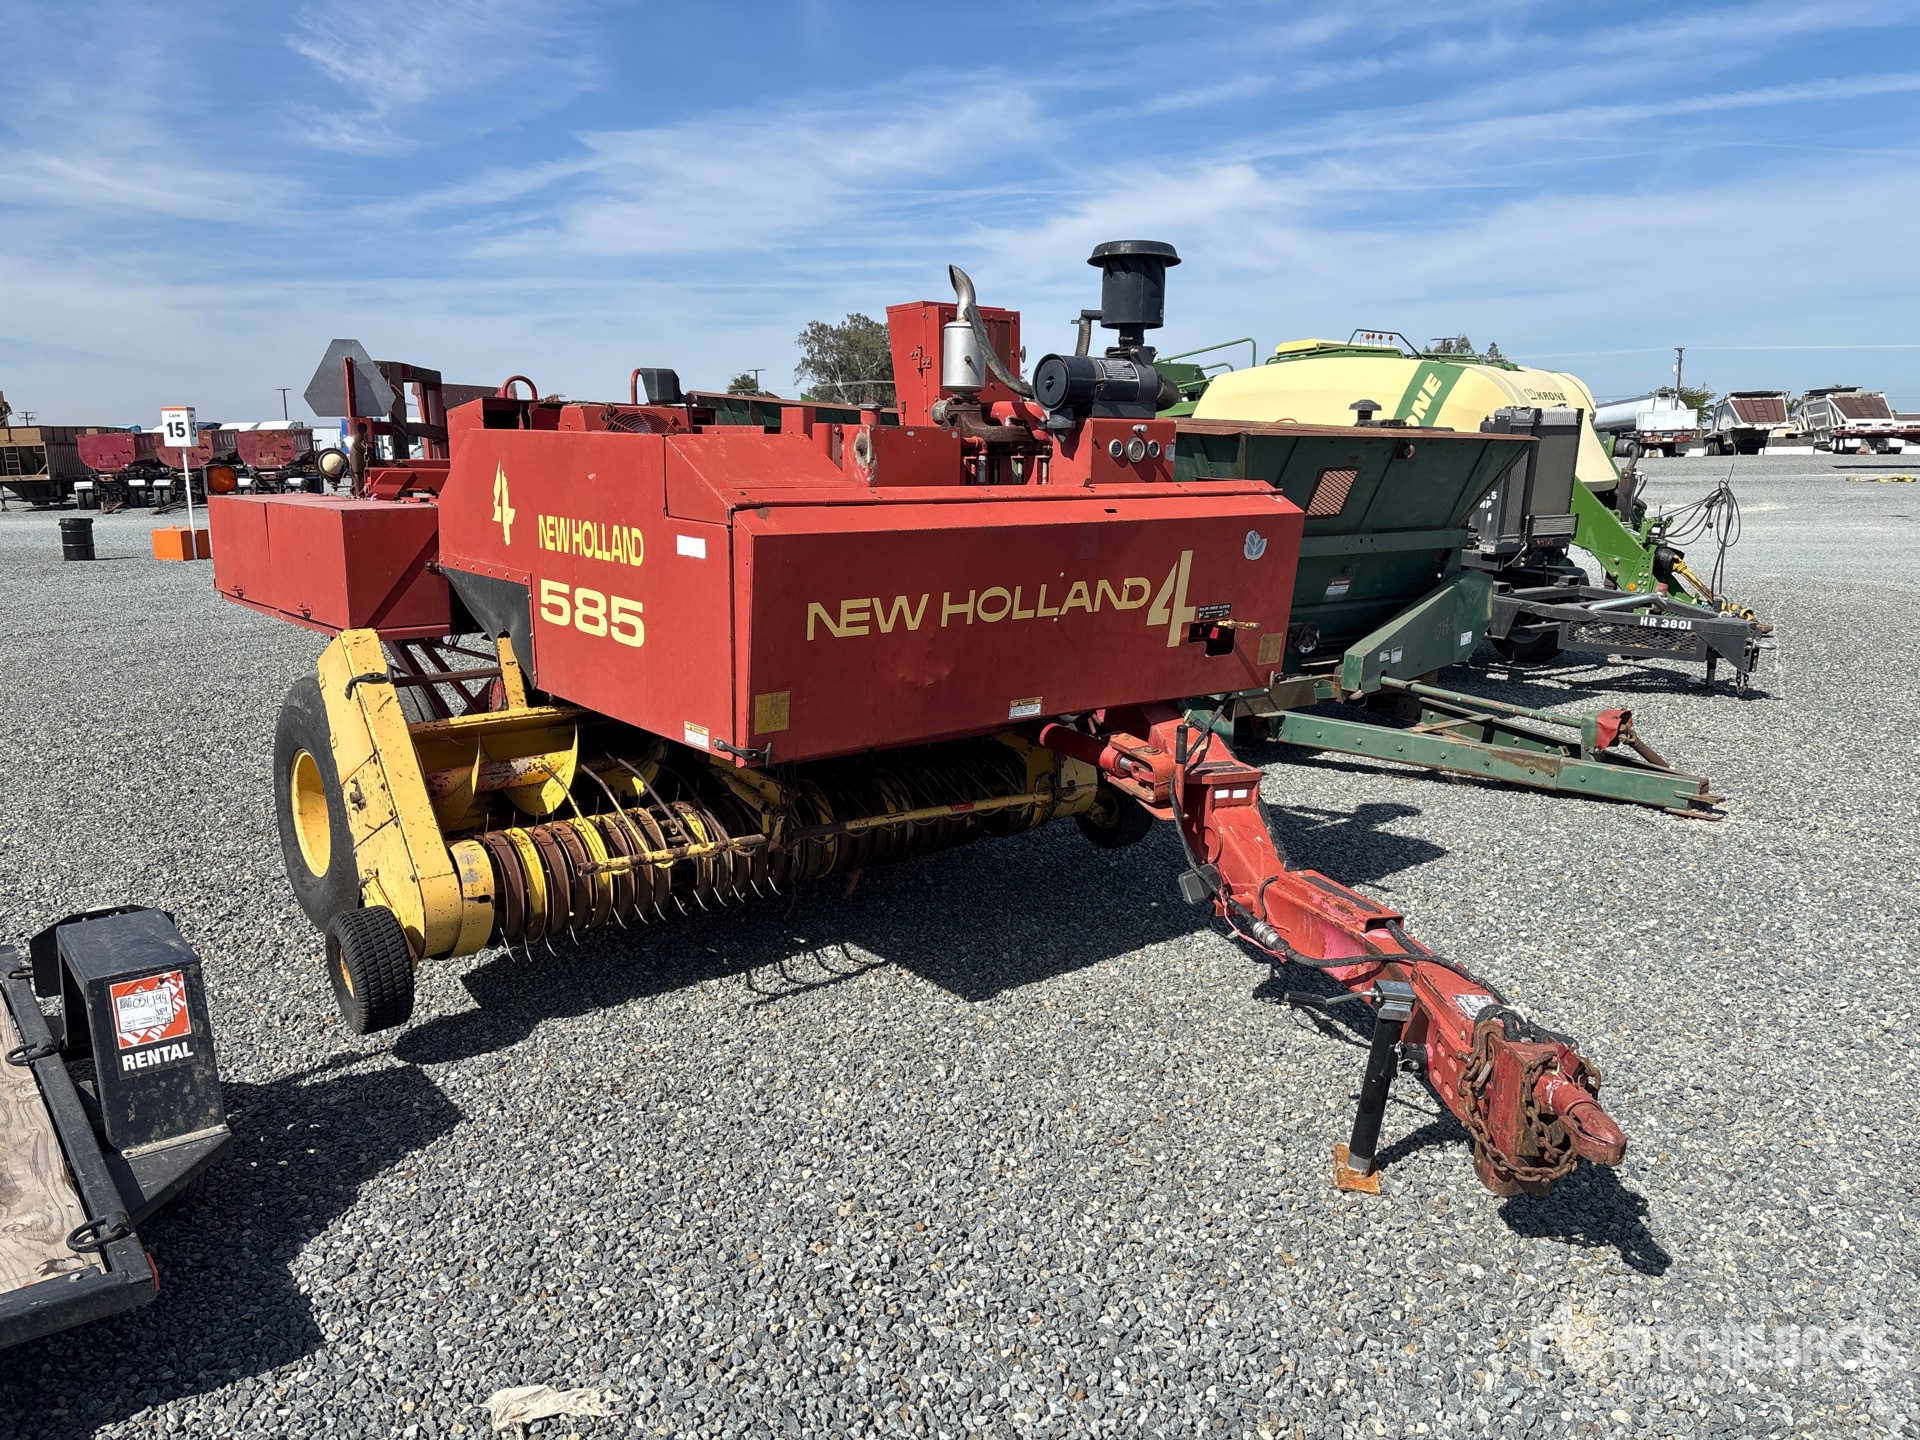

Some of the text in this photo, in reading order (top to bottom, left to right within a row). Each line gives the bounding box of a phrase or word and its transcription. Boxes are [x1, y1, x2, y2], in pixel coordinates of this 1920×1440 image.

[1537, 391, 1567, 401] KRONE
[167, 421, 186, 438] 15
[540, 578, 645, 648] 585
[806, 593, 930, 641] NEW
[941, 577, 1152, 628] HOLLAND
[1640, 616, 1692, 630] HR 3801
[122, 1042, 194, 1071] RENTAL
